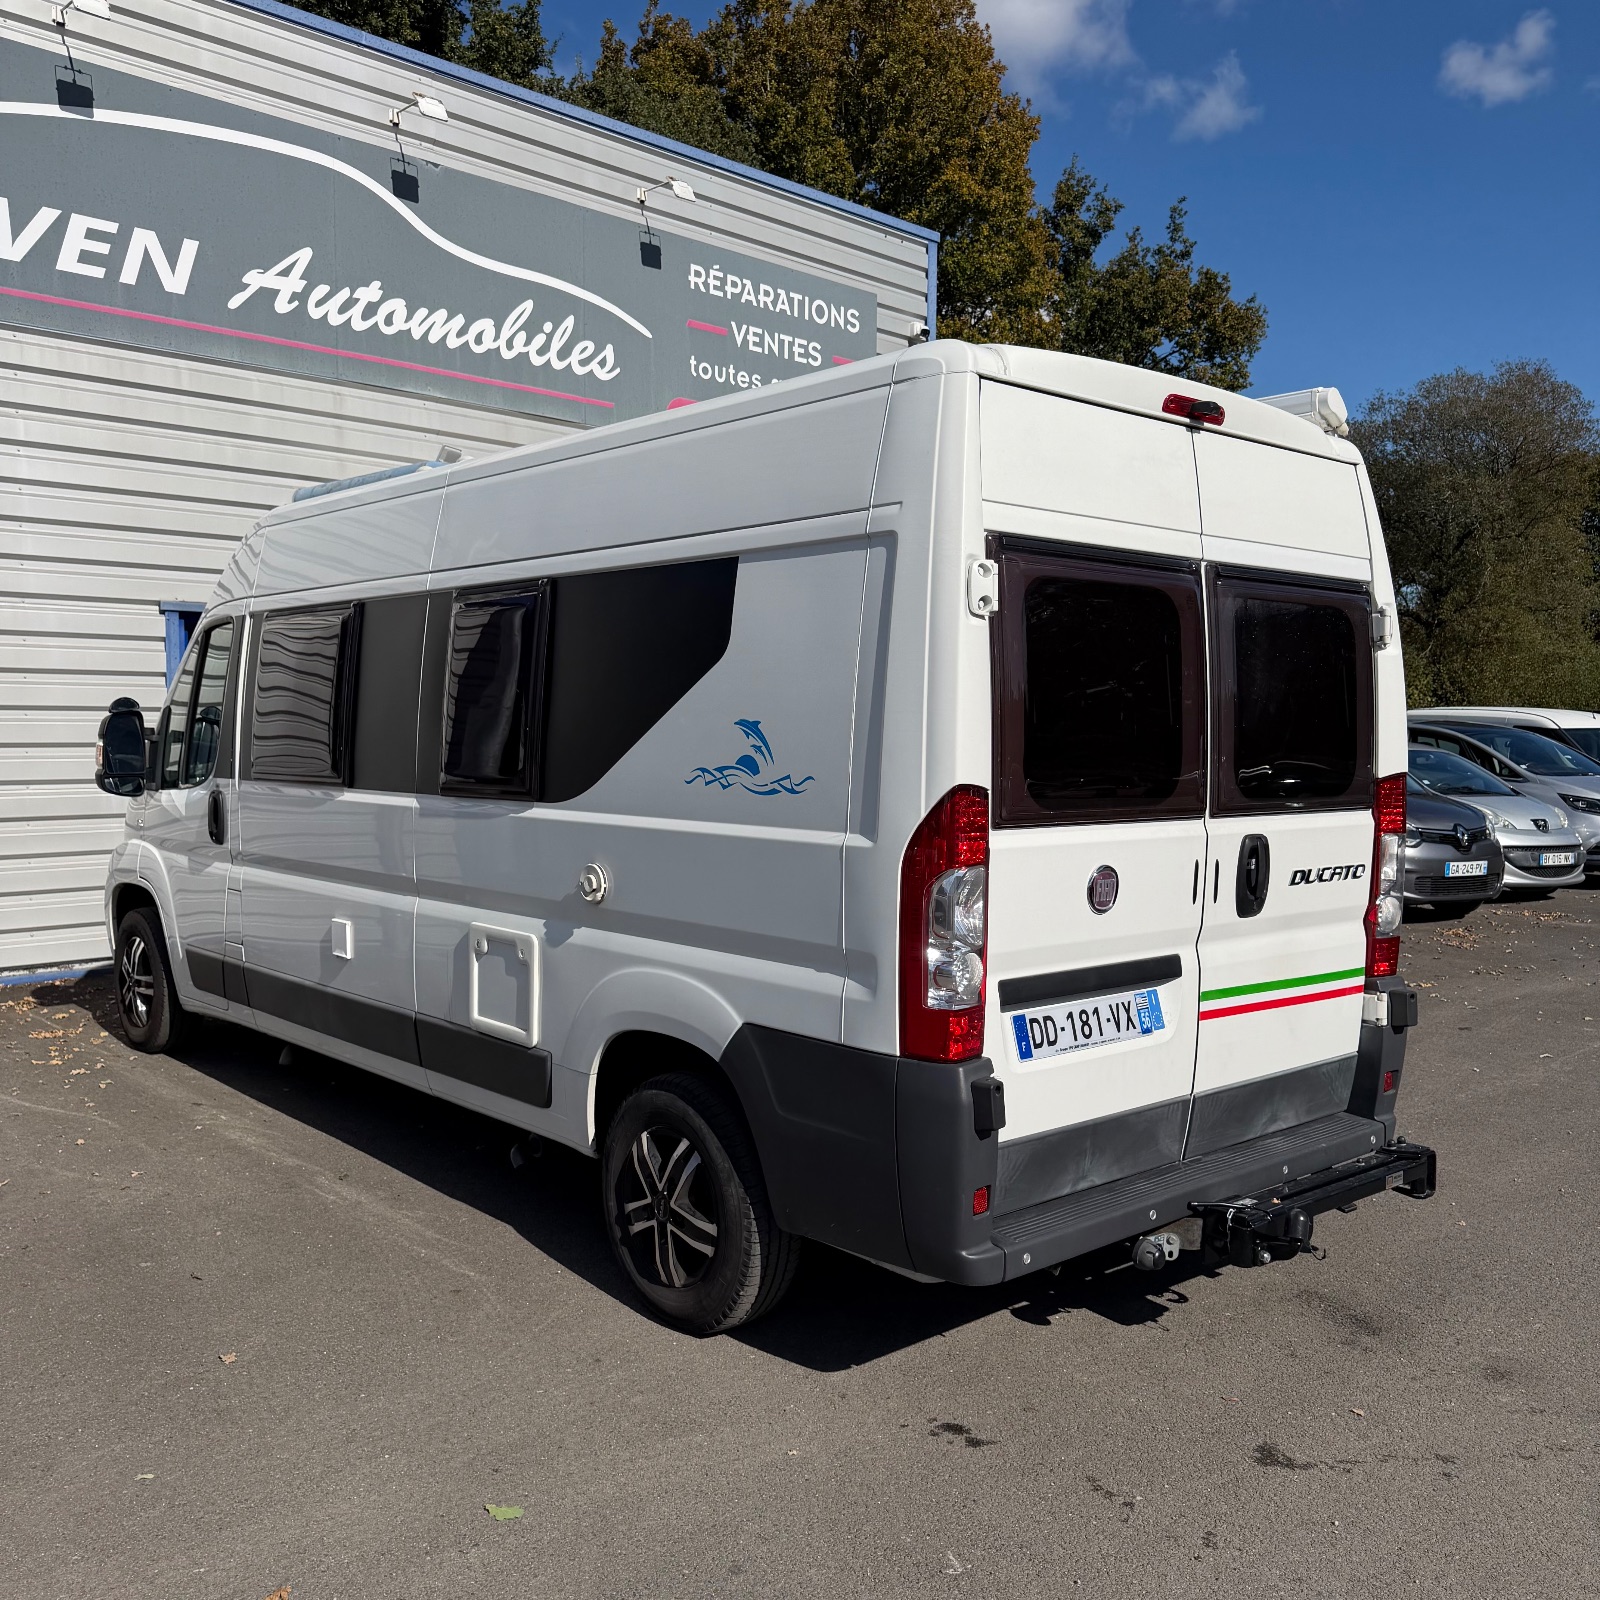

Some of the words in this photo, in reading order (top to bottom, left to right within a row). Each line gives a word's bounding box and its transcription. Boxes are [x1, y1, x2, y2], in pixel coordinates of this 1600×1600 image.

[228, 247, 620, 381] Automobiles
[688, 264, 860, 333] RÉPARATIONS
[731, 321, 822, 367] VENTES
[690, 355, 761, 388] toutes
[1095, 879, 1115, 901] FIAT
[1289, 864, 1366, 886] DUCATO
[1029, 1001, 1137, 1049] DD-181-VX
